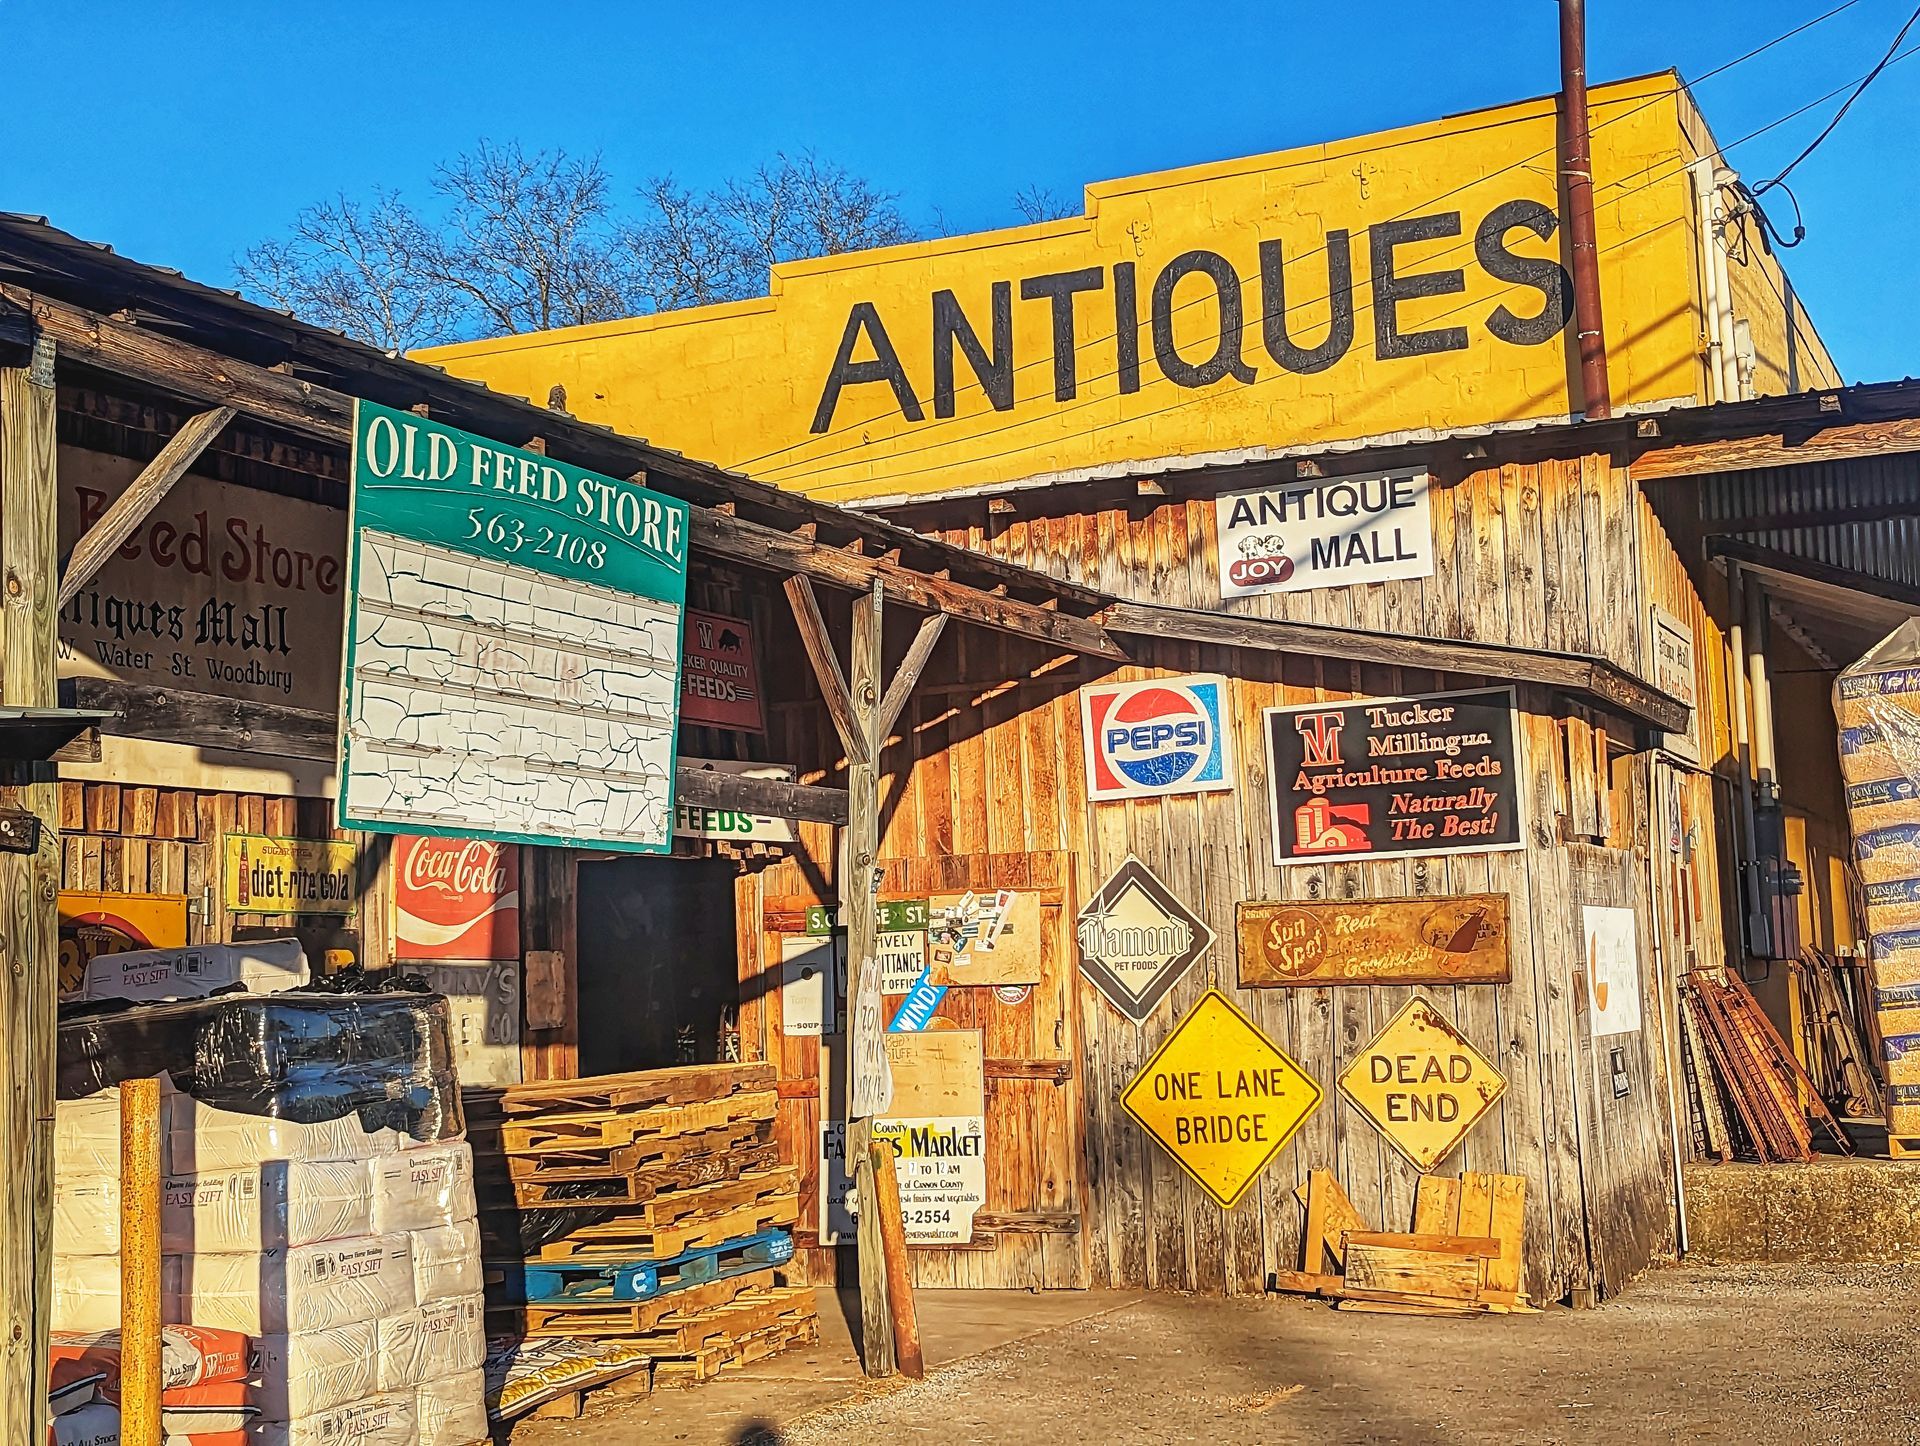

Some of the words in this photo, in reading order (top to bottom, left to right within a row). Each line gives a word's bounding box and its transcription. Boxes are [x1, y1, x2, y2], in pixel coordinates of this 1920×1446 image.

[810, 199, 1575, 434] ANTIQUES
[366, 416, 458, 482] OLD
[469, 444, 568, 503] FEED
[575, 477, 683, 563] STORE
[1228, 476, 1416, 530] ANTIQUE
[462, 508, 607, 569] 563-2108
[1311, 528, 1417, 571] MALL
[221, 517, 340, 594] Store
[1232, 558, 1287, 580] JOY
[59, 579, 186, 642] tiques
[195, 597, 292, 656] Mall
[94, 639, 153, 670] Water
[171, 653, 196, 678] St.
[206, 657, 292, 694] Woodbury
[709, 659, 749, 678] QUALITY
[687, 673, 737, 702] FEEDS
[1365, 704, 1455, 729] Tucker
[1107, 721, 1207, 754] PEPSI
[1367, 732, 1461, 757] Milling
[1292, 765, 1428, 794] Agriculture
[1435, 756, 1502, 780] Feeds
[1388, 787, 1498, 815] Naturally
[676, 805, 753, 833] FEEDS
[1390, 818, 1434, 841] The
[1440, 812, 1498, 837] Best!
[404, 836, 507, 894] Coca-Cola
[251, 859, 317, 901] diet-rite
[319, 868, 349, 901] cola
[906, 907, 926, 923] ST.
[1334, 911, 1379, 936] Real
[1079, 916, 1194, 960] Diamond
[1267, 918, 1306, 950] Sun
[1114, 962, 1130, 971] PET
[1132, 960, 1158, 970] FOODS
[1279, 932, 1323, 972] Spot
[123, 971, 148, 985] EASY
[149, 968, 171, 982] SIFT
[1154, 1072, 1202, 1100] ONE
[1216, 1068, 1285, 1099] LANE
[1370, 1054, 1472, 1086] DEAD
[1387, 1093, 1459, 1123] END
[1176, 1114, 1268, 1145] BRIDGE
[411, 1169, 429, 1182] EASY
[920, 1165, 931, 1174] TO
[165, 1193, 194, 1205] EASY
[198, 1190, 223, 1203] SIFT
[341, 1260, 362, 1275] EASY
[364, 1258, 383, 1272] SIFT
[423, 1318, 442, 1332] EASY
[349, 1416, 371, 1434] EASY
[373, 1412, 390, 1427] SIFT
[94, 1434, 117, 1445] STOCK
